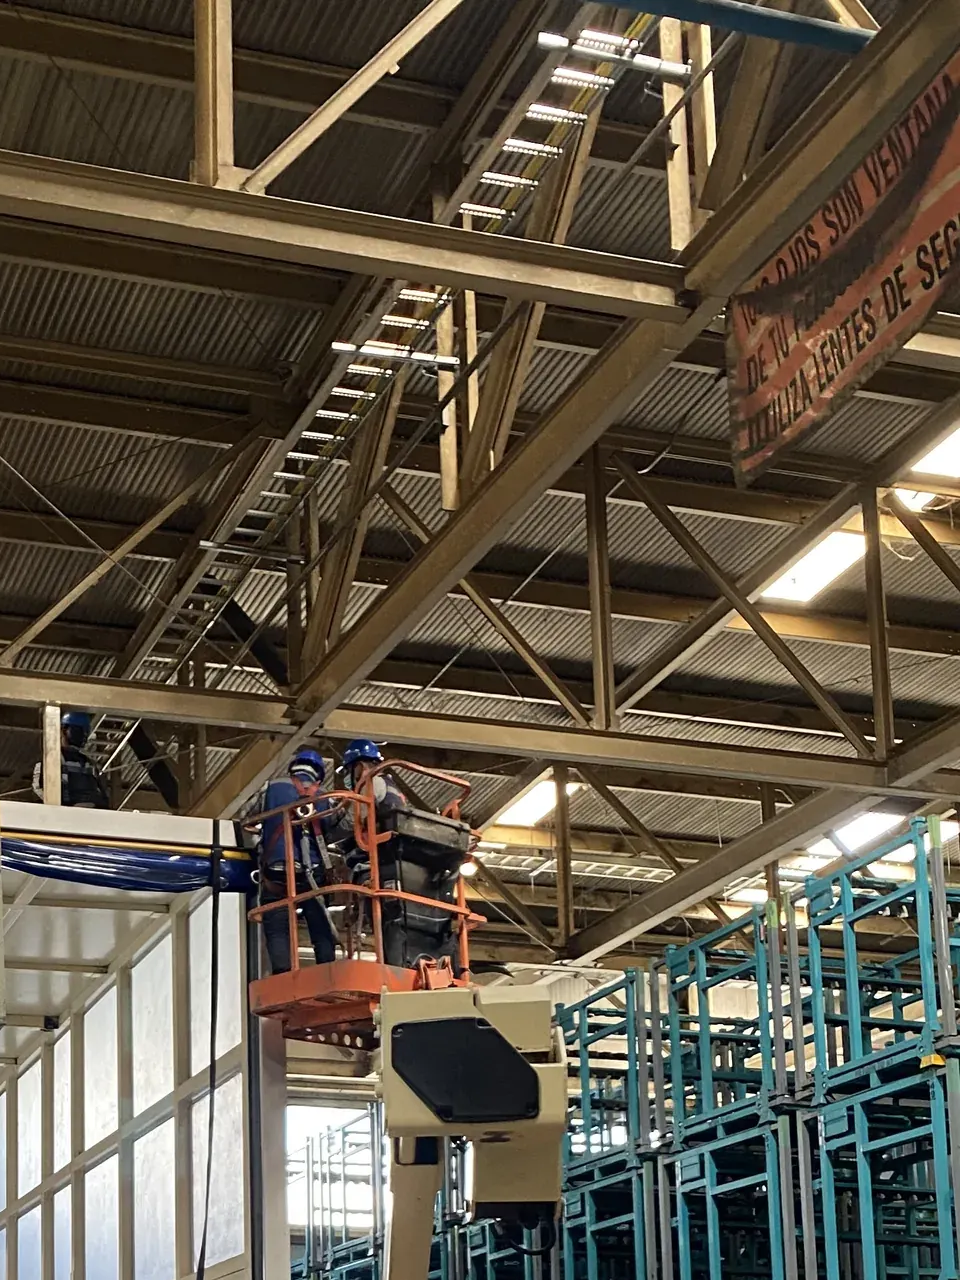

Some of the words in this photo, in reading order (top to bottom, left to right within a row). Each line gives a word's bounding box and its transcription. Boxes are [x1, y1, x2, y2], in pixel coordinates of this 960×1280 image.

[821, 173, 864, 246] SON
[812, 297, 877, 393] LENTES
[881, 263, 911, 324] DE
[916, 214, 960, 290] SEG
